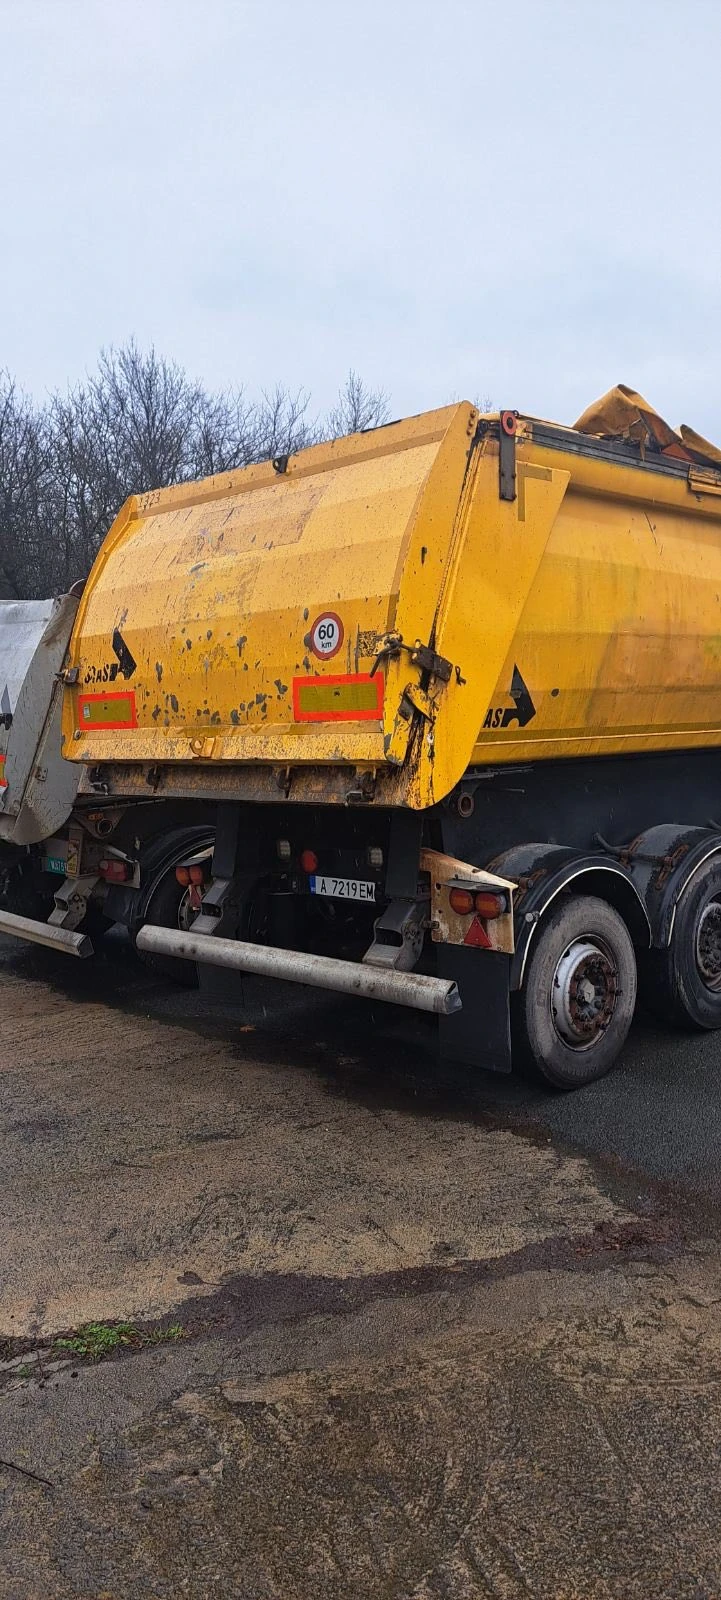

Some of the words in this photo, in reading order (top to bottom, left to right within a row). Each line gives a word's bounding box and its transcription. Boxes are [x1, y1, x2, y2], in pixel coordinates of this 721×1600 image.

[318, 623, 335, 640] 60
[321, 641, 332, 649] km
[320, 878, 327, 894] A
[331, 879, 358, 897] 7219
[359, 883, 375, 900] EM
